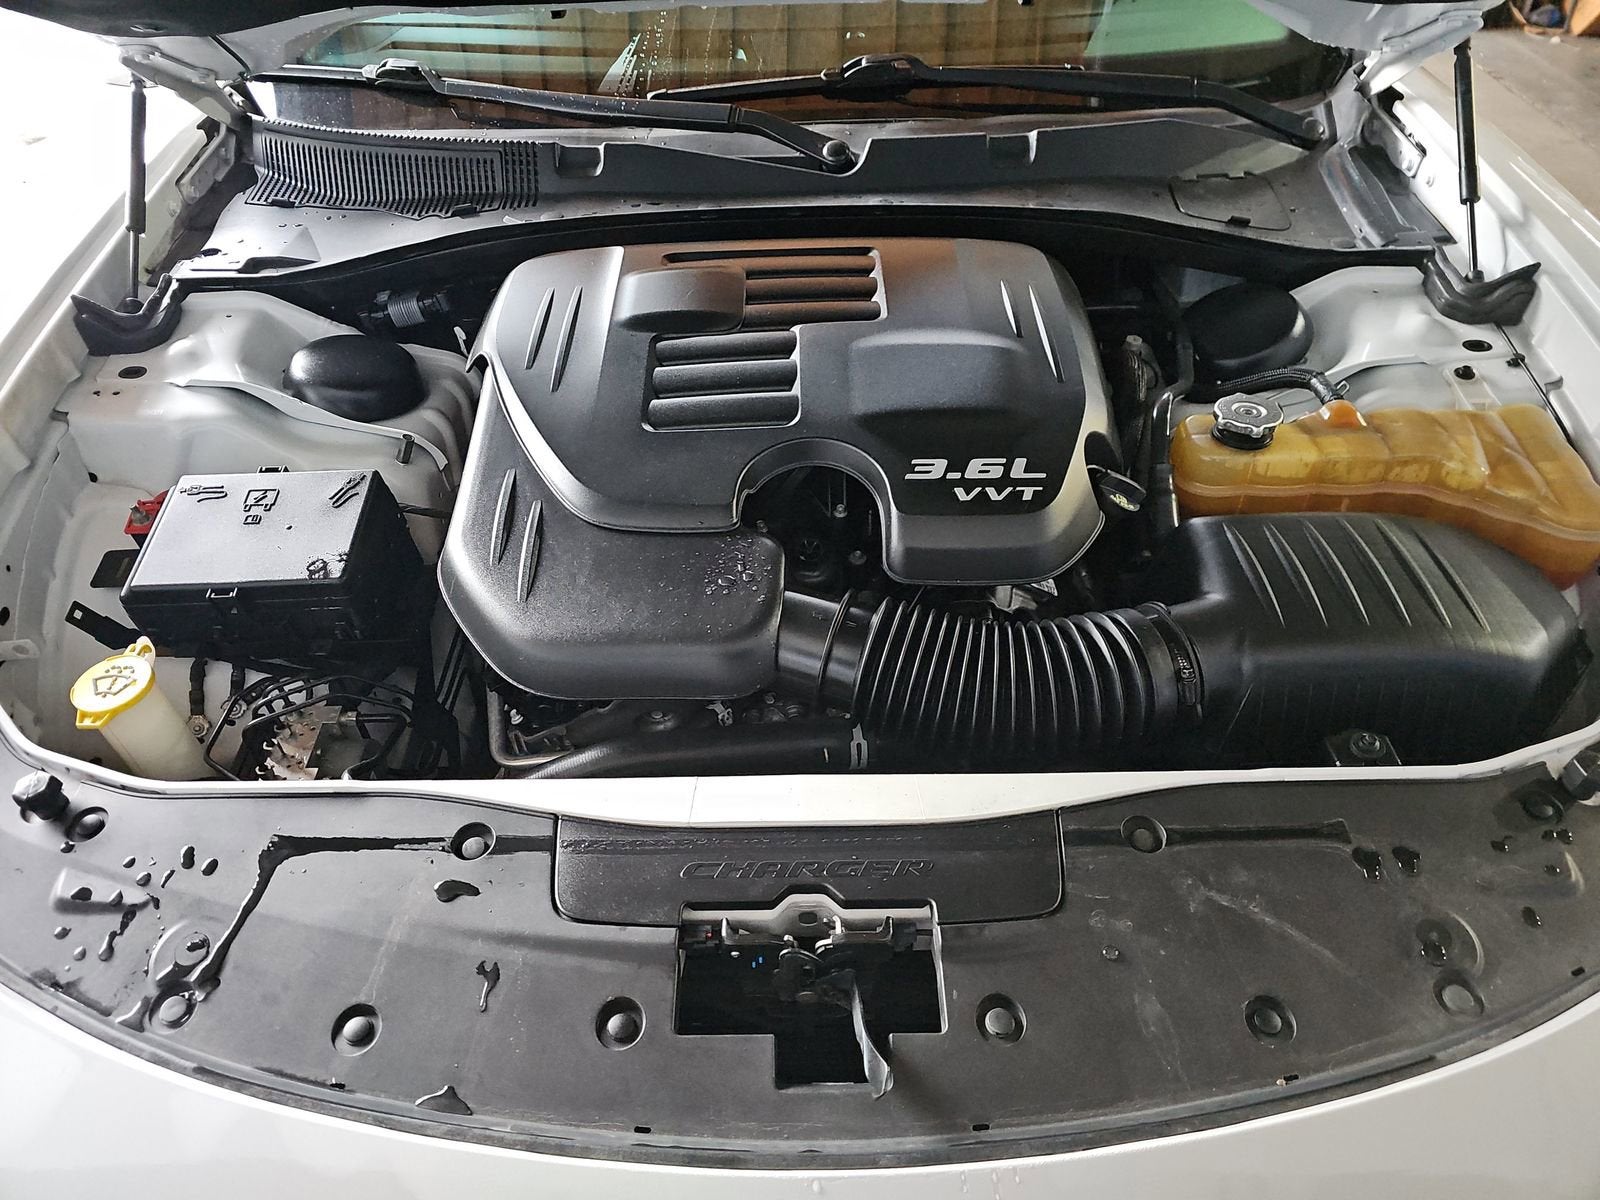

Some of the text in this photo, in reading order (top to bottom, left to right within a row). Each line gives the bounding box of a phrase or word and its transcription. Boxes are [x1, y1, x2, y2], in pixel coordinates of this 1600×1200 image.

[904, 457, 1048, 480] 3.6L
[953, 486, 1044, 502] VVT
[679, 858, 935, 880] CHARGER
